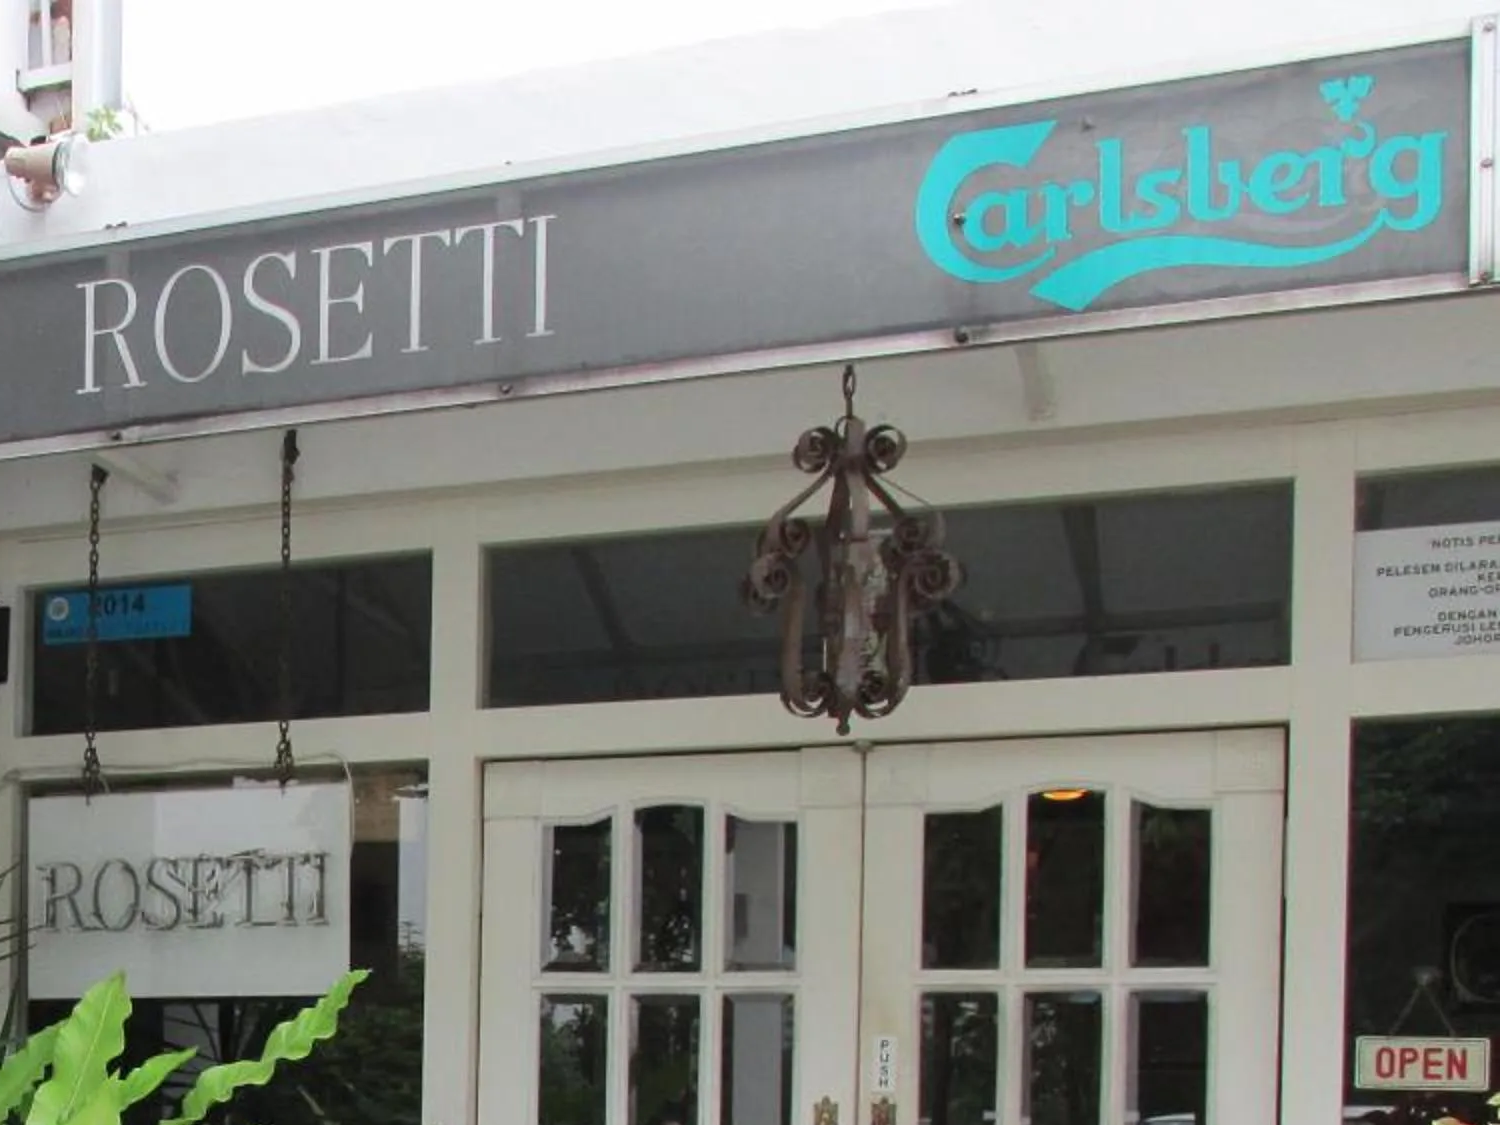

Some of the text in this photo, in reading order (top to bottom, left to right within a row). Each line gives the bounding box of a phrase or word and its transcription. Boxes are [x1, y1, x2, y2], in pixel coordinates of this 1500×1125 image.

[915, 119, 1448, 283] Carlsberg
[75, 214, 558, 395] ROSETTI
[1479, 534, 1500, 545] PE
[36, 849, 330, 933] ROSETTI
[878, 1039, 890, 1088] PUSH
[1375, 1047, 1468, 1081] OPEN
